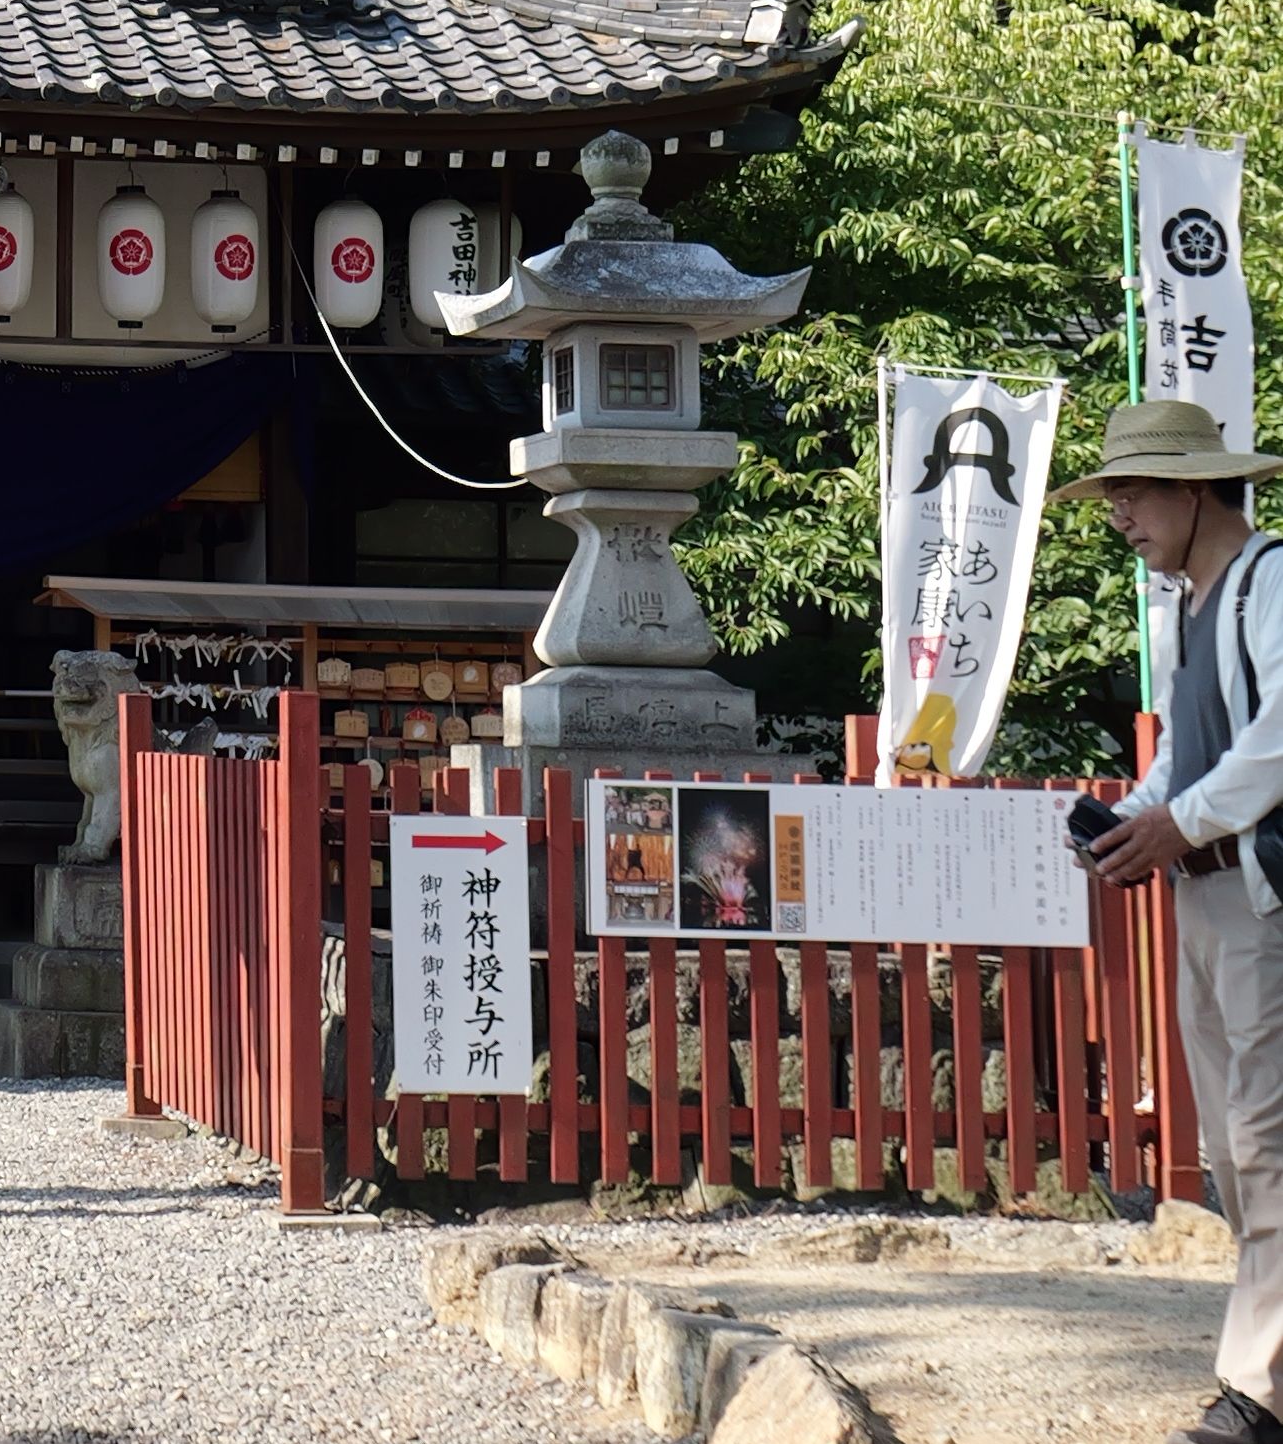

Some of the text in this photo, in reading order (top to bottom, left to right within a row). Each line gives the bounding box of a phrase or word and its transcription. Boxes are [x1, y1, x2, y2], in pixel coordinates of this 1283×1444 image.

[449, 213, 476, 295] 吉田神
[911, 538, 960, 628] 家康
[949, 540, 998, 678] あいち
[419, 873, 445, 1077] 御祈祷 御朱印受付
[462, 867, 504, 1080] 神符授与所
